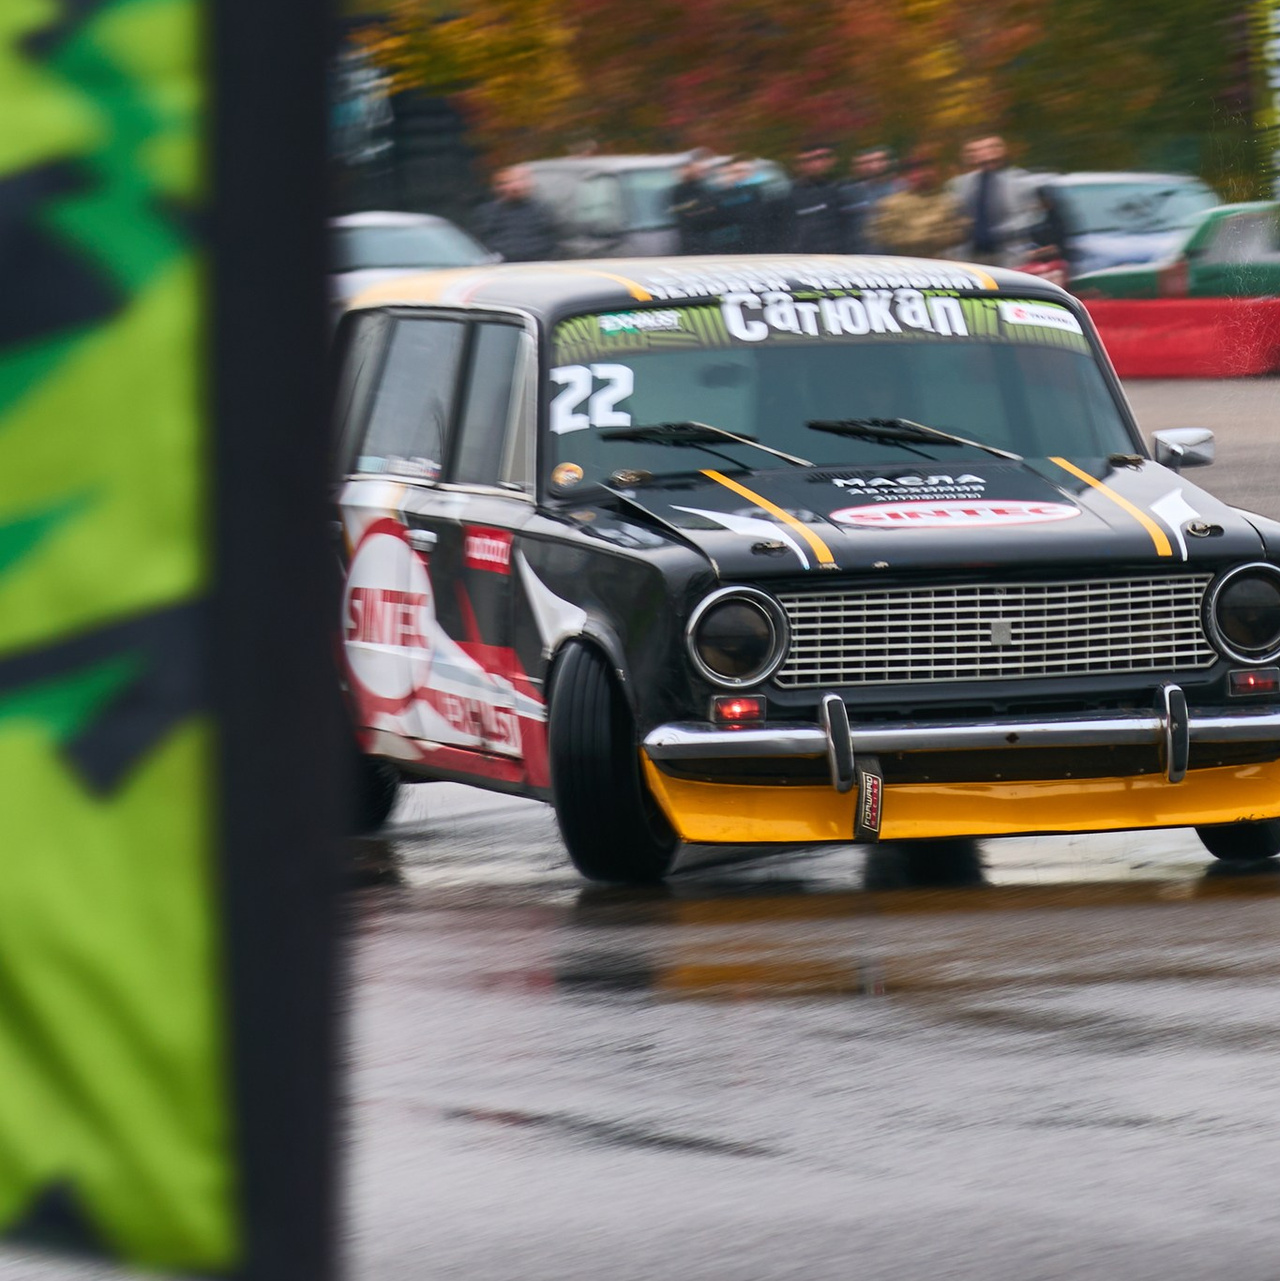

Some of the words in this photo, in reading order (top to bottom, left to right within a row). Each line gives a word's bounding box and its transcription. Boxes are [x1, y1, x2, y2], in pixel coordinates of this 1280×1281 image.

[549, 363, 634, 435] 22
[831, 473, 987, 488] МАСЛА
[850, 506, 1067, 523] SINTEC
[346, 586, 431, 649] SINTEC
[864, 775, 873, 826] FORWARD
